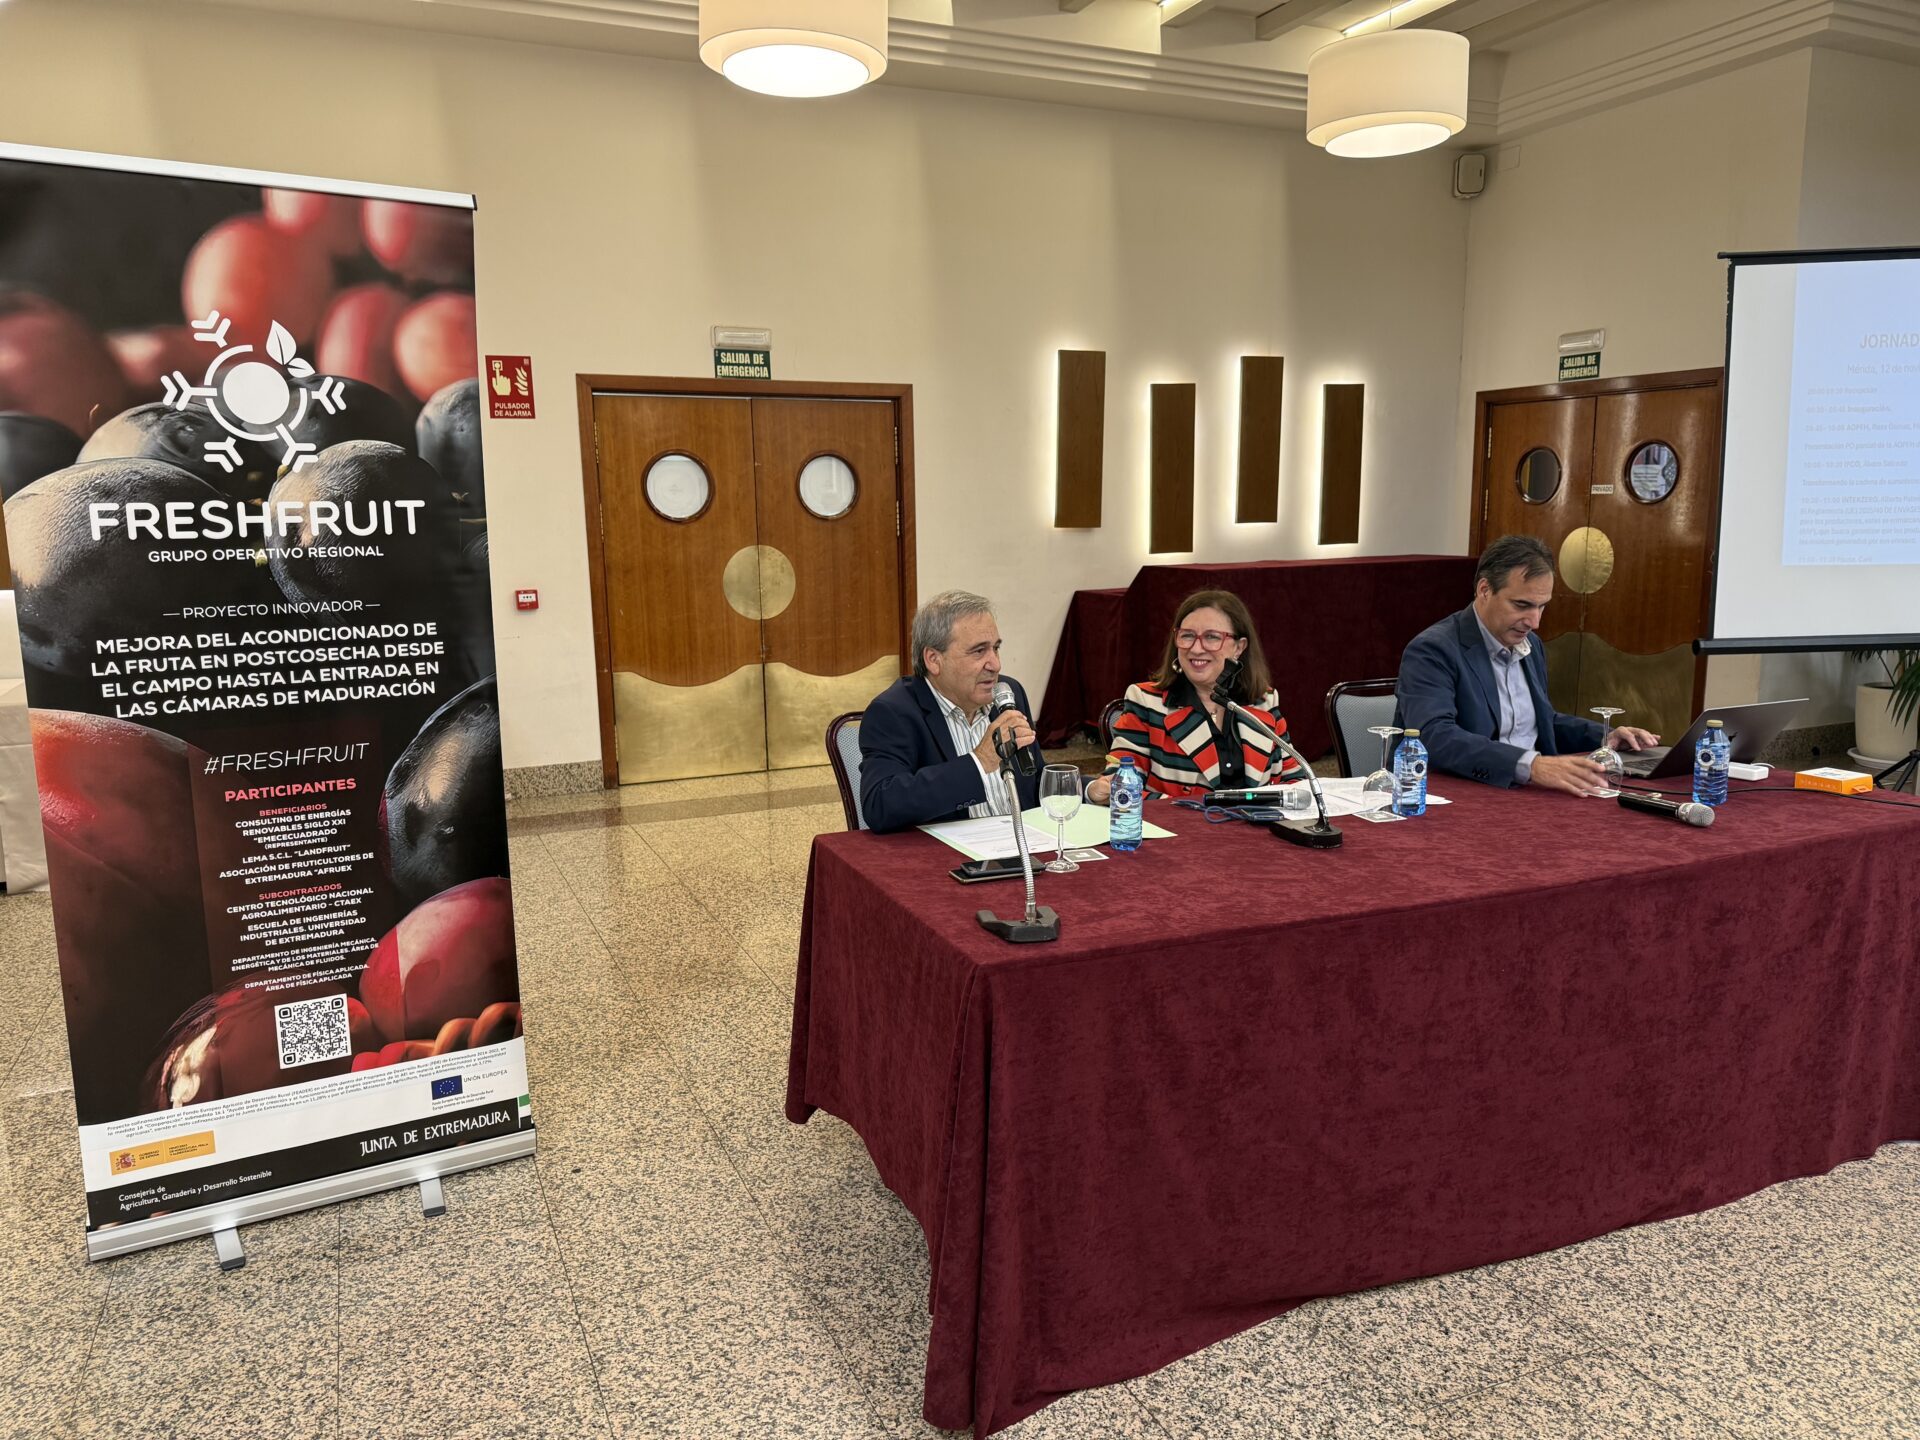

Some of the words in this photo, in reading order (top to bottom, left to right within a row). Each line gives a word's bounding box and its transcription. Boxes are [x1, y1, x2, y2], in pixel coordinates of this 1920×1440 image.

[721, 352, 750, 364] SALIDA
[753, 353, 764, 364] DE
[1564, 356, 1585, 368] SALIDA
[1587, 355, 1596, 365] DE
[717, 365, 769, 377] EMERGENCIA
[1560, 366, 1598, 379] EMERGENCIA
[88, 500, 425, 541] FRESHFRUIT
[148, 549, 207, 563] GRUPO
[212, 547, 303, 561] OPERATIVO
[308, 545, 384, 558] REGIONAL
[96, 635, 192, 654] MEJORA
[196, 632, 236, 649] DEL
[240, 624, 408, 646] ACONDICIONADO
[413, 622, 437, 636] DE
[91, 661, 120, 676] LA
[126, 656, 196, 674] FRUTA
[200, 654, 228, 669] EN
[234, 646, 381, 667] POSTCOSECHA
[385, 642, 444, 657] DESDE
[102, 682, 128, 698] EL
[132, 676, 212, 696] CAMPO
[218, 672, 286, 689] HASTA
[290, 669, 312, 684] LA
[320, 663, 412, 682] ENTRADA
[415, 662, 440, 676] EN
[116, 701, 158, 719] LAS
[162, 692, 268, 714] CÁMARAS
[274, 691, 299, 706] DE
[304, 680, 435, 704] MADURACIÓN
[204, 742, 370, 775] #FRESHFRUIT
[225, 778, 356, 801] PARTICIPANTES
[235, 816, 292, 828] CONSULTING
[308, 809, 351, 819] ENERGÍAS
[260, 803, 327, 815] BENEFICIARIOS
[243, 824, 302, 836] RENOVABLES
[305, 820, 330, 829] SIGLO
[331, 818, 346, 826] XXI
[265, 837, 327, 849] (REPRESENTANTE)
[242, 854, 268, 863] LEMA
[270, 852, 292, 860] S.C.L.
[294, 845, 350, 856] "LANDFRUIT"
[220, 865, 276, 877] ASOCIACIÓN
[278, 863, 290, 871] DE
[292, 854, 361, 868] FRUTICULTORES
[363, 852, 374, 860] DE
[245, 870, 313, 884] EXTREMADURA
[227, 903, 263, 913] CENTRO
[266, 894, 327, 907] TECNOLÓGICO
[329, 887, 374, 898] NACIONAL
[259, 884, 342, 899] SUBCONTRATADOS
[241, 903, 326, 919] AGROALIMENTARIO
[334, 898, 362, 907] CTAEX
[240, 926, 306, 941] INDUSTRIALES.
[308, 917, 366, 930] UNIVERSIDAD
[248, 920, 288, 931] ESCUELA
[303, 910, 358, 923] INGENIERÍAS
[279, 929, 344, 943] EXTREMADURA
[232, 951, 289, 964] DEPARTAMENTO
[301, 943, 339, 953] INGENIERÍA
[232, 959, 275, 971] ENERGÉTICA
[351, 944, 369, 952] ÁREA
[268, 961, 304, 972] MECÁNICA
[316, 955, 346, 964] FLUIDOS.
[245, 975, 301, 988] DEPARTAMENTO
[313, 969, 334, 977] FÍSICA
[319, 973, 352, 983] APLICADA
[482, 1069, 508, 1078] EUROPEA
[360, 1136, 397, 1156] JUNTA
[404, 1130, 418, 1145] DE
[424, 1110, 510, 1140] EXTREMADURA
[120, 1196, 161, 1211] Agricultura,
[204, 1179, 237, 1191] Desarrollo
[239, 1170, 272, 1183] Sostenible
